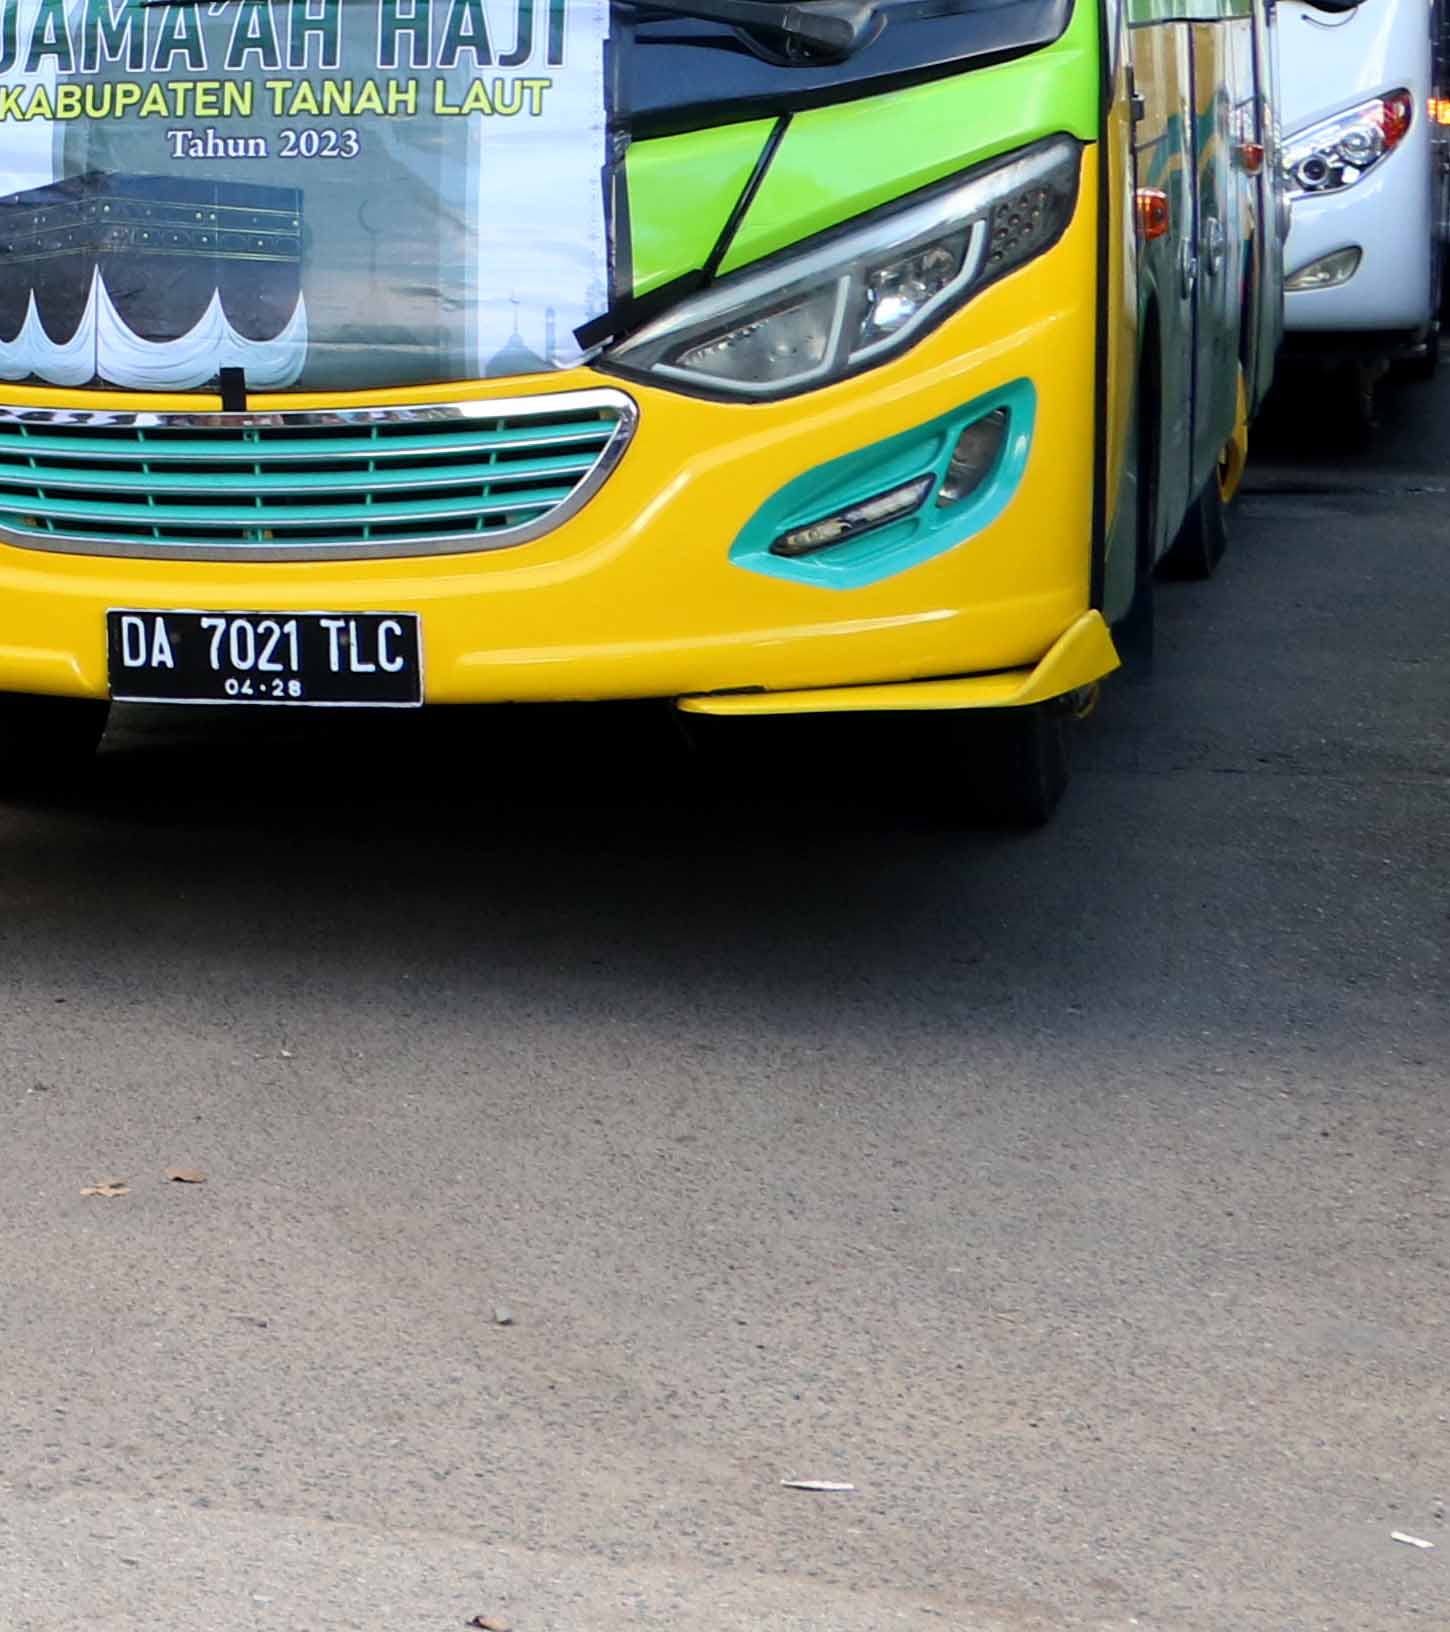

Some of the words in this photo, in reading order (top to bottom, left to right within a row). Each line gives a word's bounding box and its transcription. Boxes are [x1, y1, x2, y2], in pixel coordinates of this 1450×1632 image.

[265, 78, 418, 118] TANAH
[433, 77, 552, 117] LAUT
[167, 128, 268, 159] Tahun
[278, 129, 361, 159] 2023
[121, 616, 175, 669] DA
[200, 616, 299, 672] 7021
[319, 618, 404, 673] TLC
